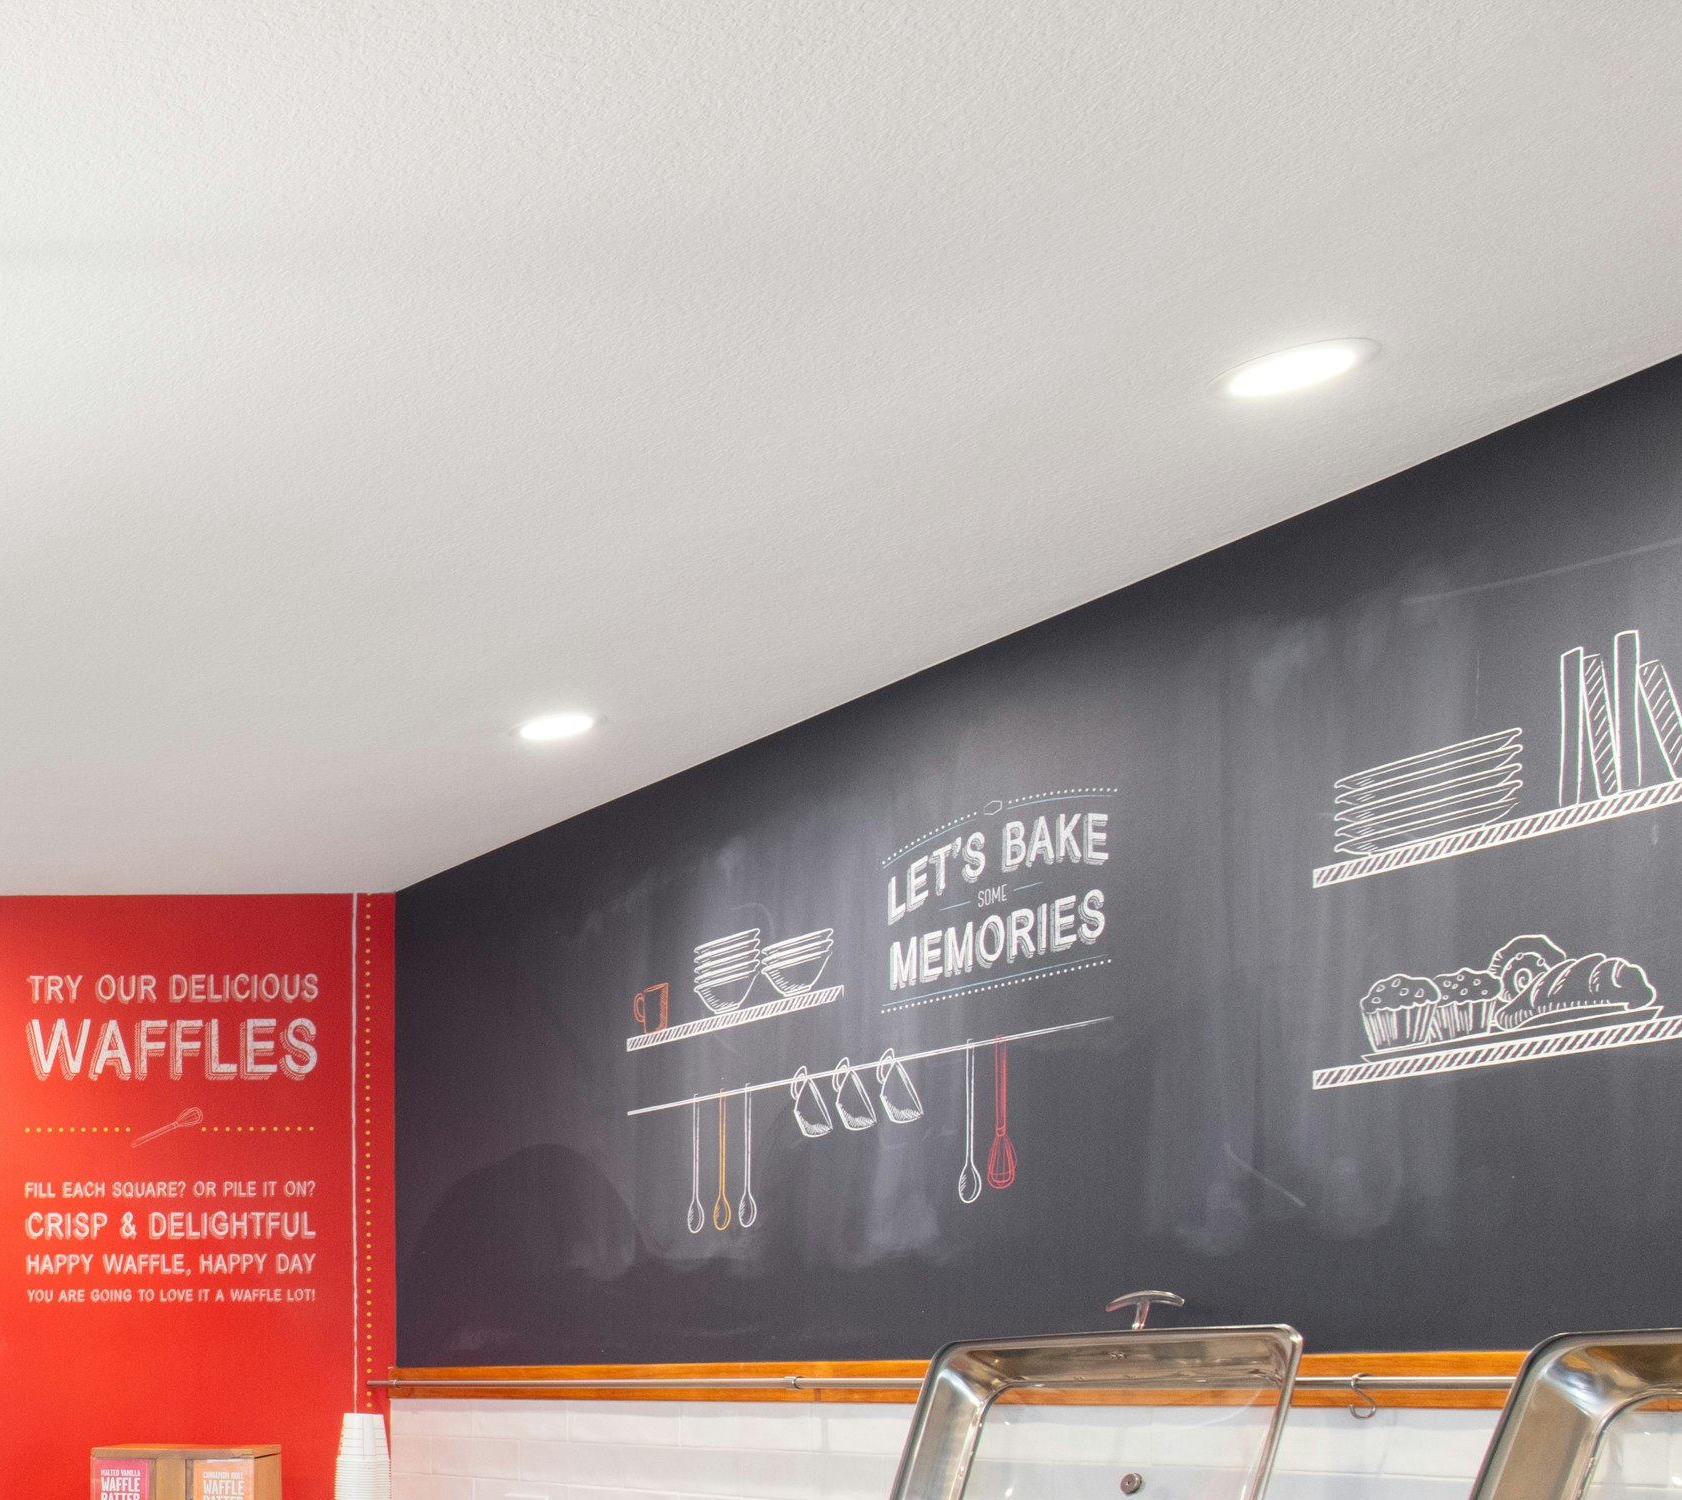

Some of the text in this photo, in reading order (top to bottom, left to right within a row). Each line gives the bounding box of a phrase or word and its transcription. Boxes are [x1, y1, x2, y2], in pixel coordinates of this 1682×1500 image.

[888, 812, 1109, 926] LET'S BAKE
[977, 884, 1008, 908] SOME
[890, 889, 1106, 991] MEMORIES
[28, 973, 319, 1004] TRY OUR DELICIOUS
[26, 1017, 319, 1081] WAFFLES
[24, 1180, 316, 1199] FILL EACH SQUARE? OR PILE IT ON?
[25, 1210, 316, 1240] CRISP & DELIGHTFUL
[26, 1253, 317, 1277] HAPPY WAFFLE, HAPPY DAY
[27, 1288, 316, 1302] YOU ARE GOING TO LOVE IT A WAFFLE LOT!
[100, 1469, 119, 1477] MALTED
[100, 1477, 141, 1492] WAFFLE
[203, 1479, 244, 1496] WAFFLE
